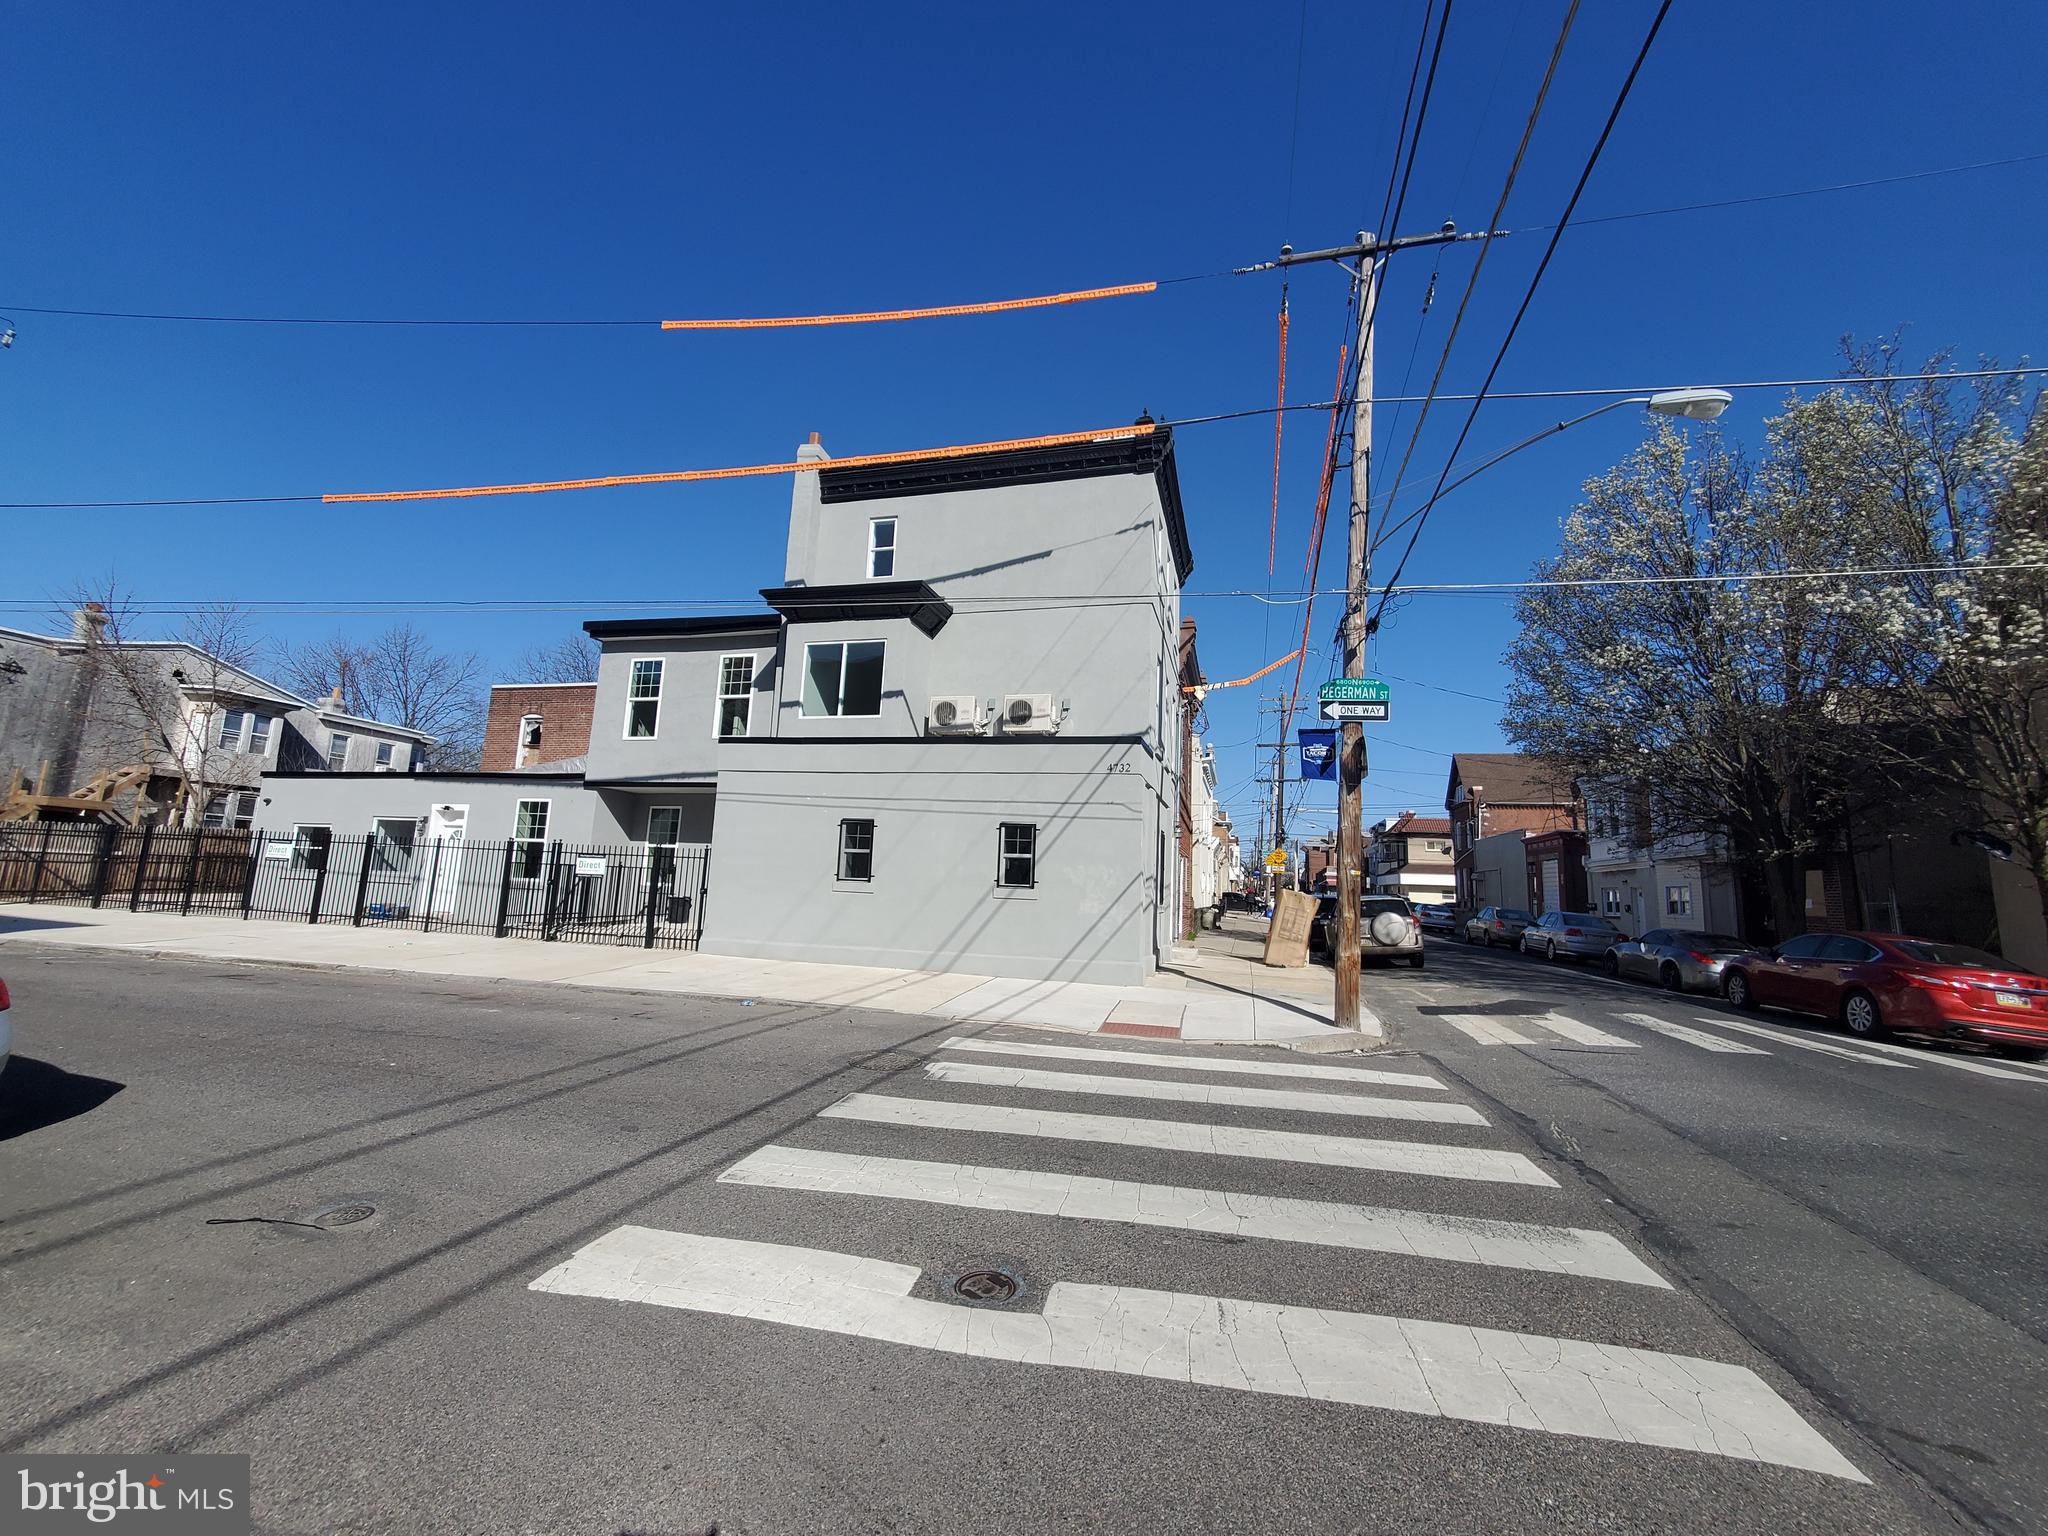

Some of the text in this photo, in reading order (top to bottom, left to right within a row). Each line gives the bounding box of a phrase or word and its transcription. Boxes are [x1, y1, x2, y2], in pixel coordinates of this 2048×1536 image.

[1321, 686, 1389, 699] HEGERMAN ST
[1340, 706, 1381, 715] ONE WAY
[1107, 763, 1131, 773] 4732
[268, 845, 288, 853] Direct
[578, 860, 602, 869] Direct
